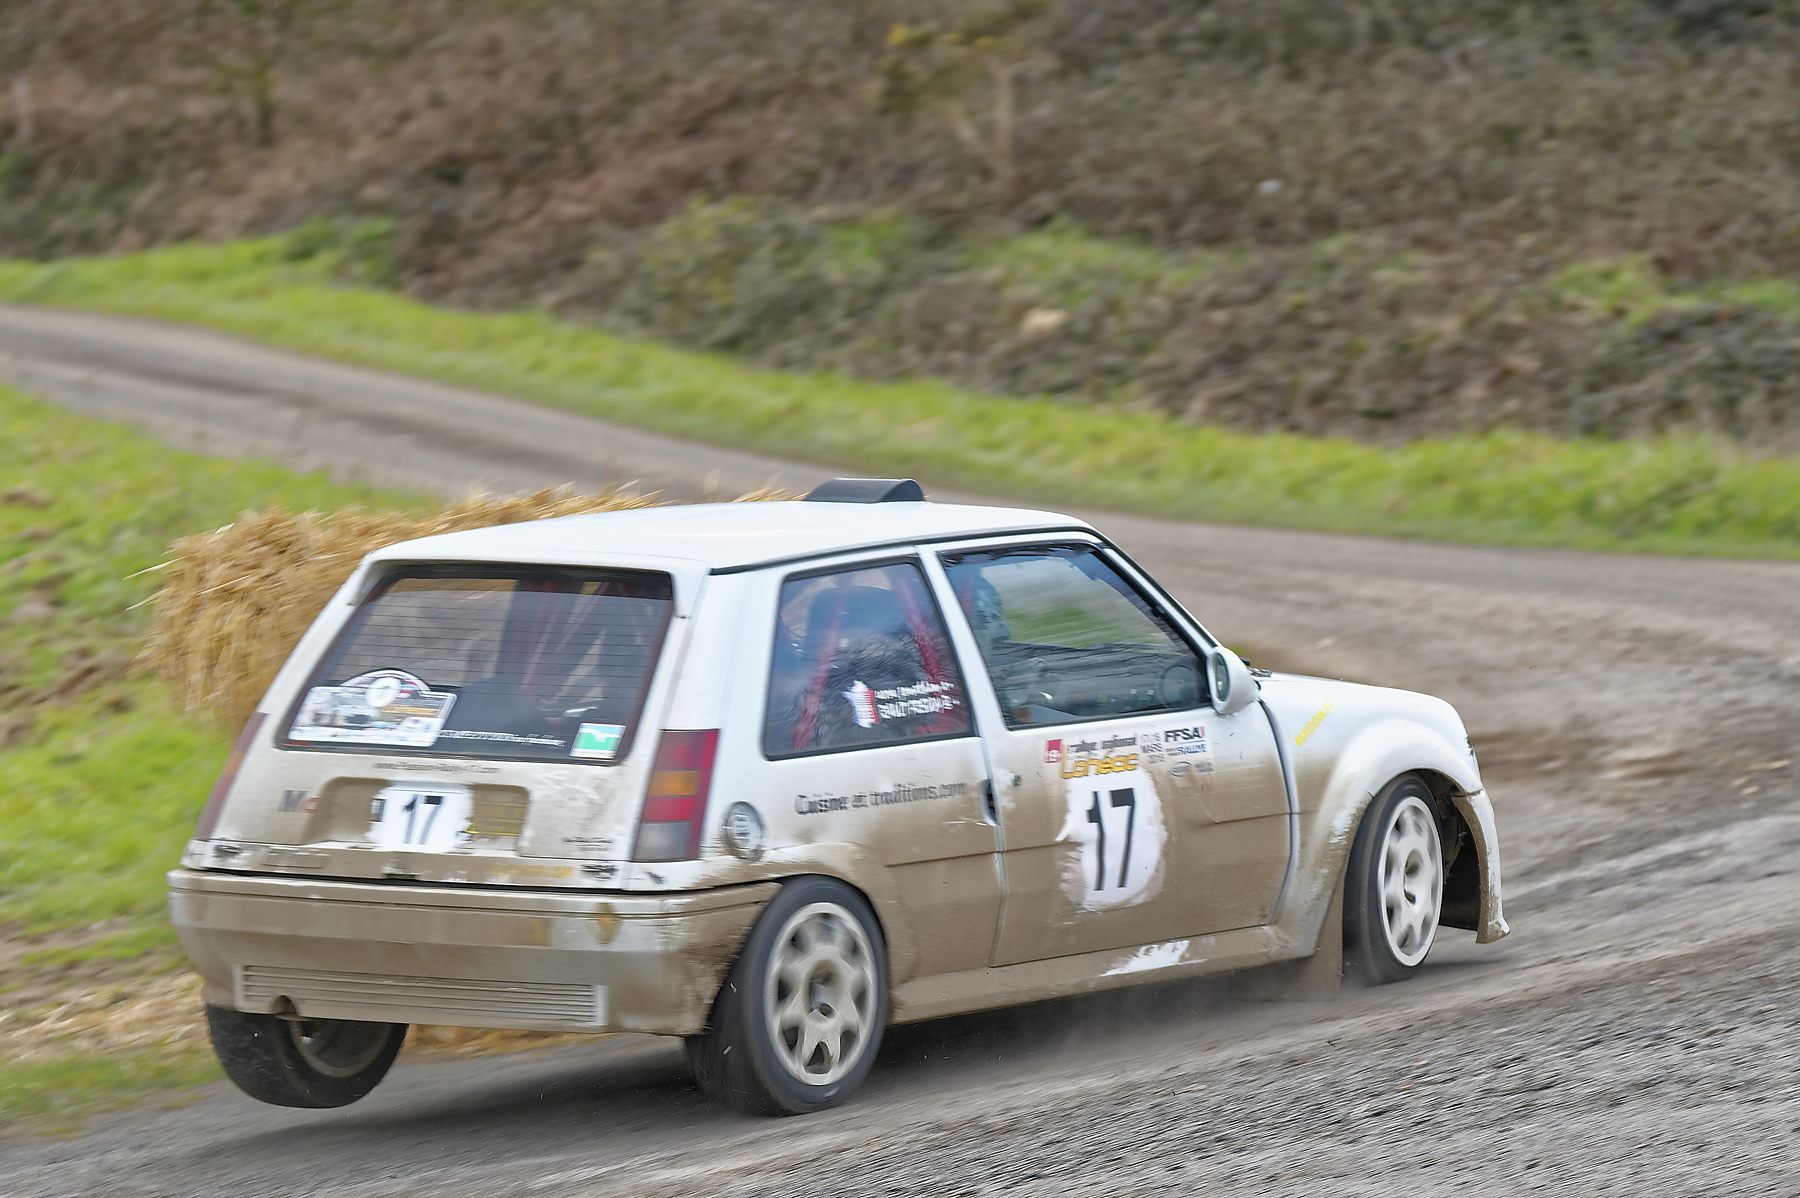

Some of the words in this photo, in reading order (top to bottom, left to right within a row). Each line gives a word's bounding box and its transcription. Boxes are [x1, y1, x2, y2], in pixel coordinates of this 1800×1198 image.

[1164, 727, 1201, 743] FFSA
[402, 793, 444, 845] 17
[794, 793, 849, 815] Cuisine
[1086, 787, 1136, 891] 17
